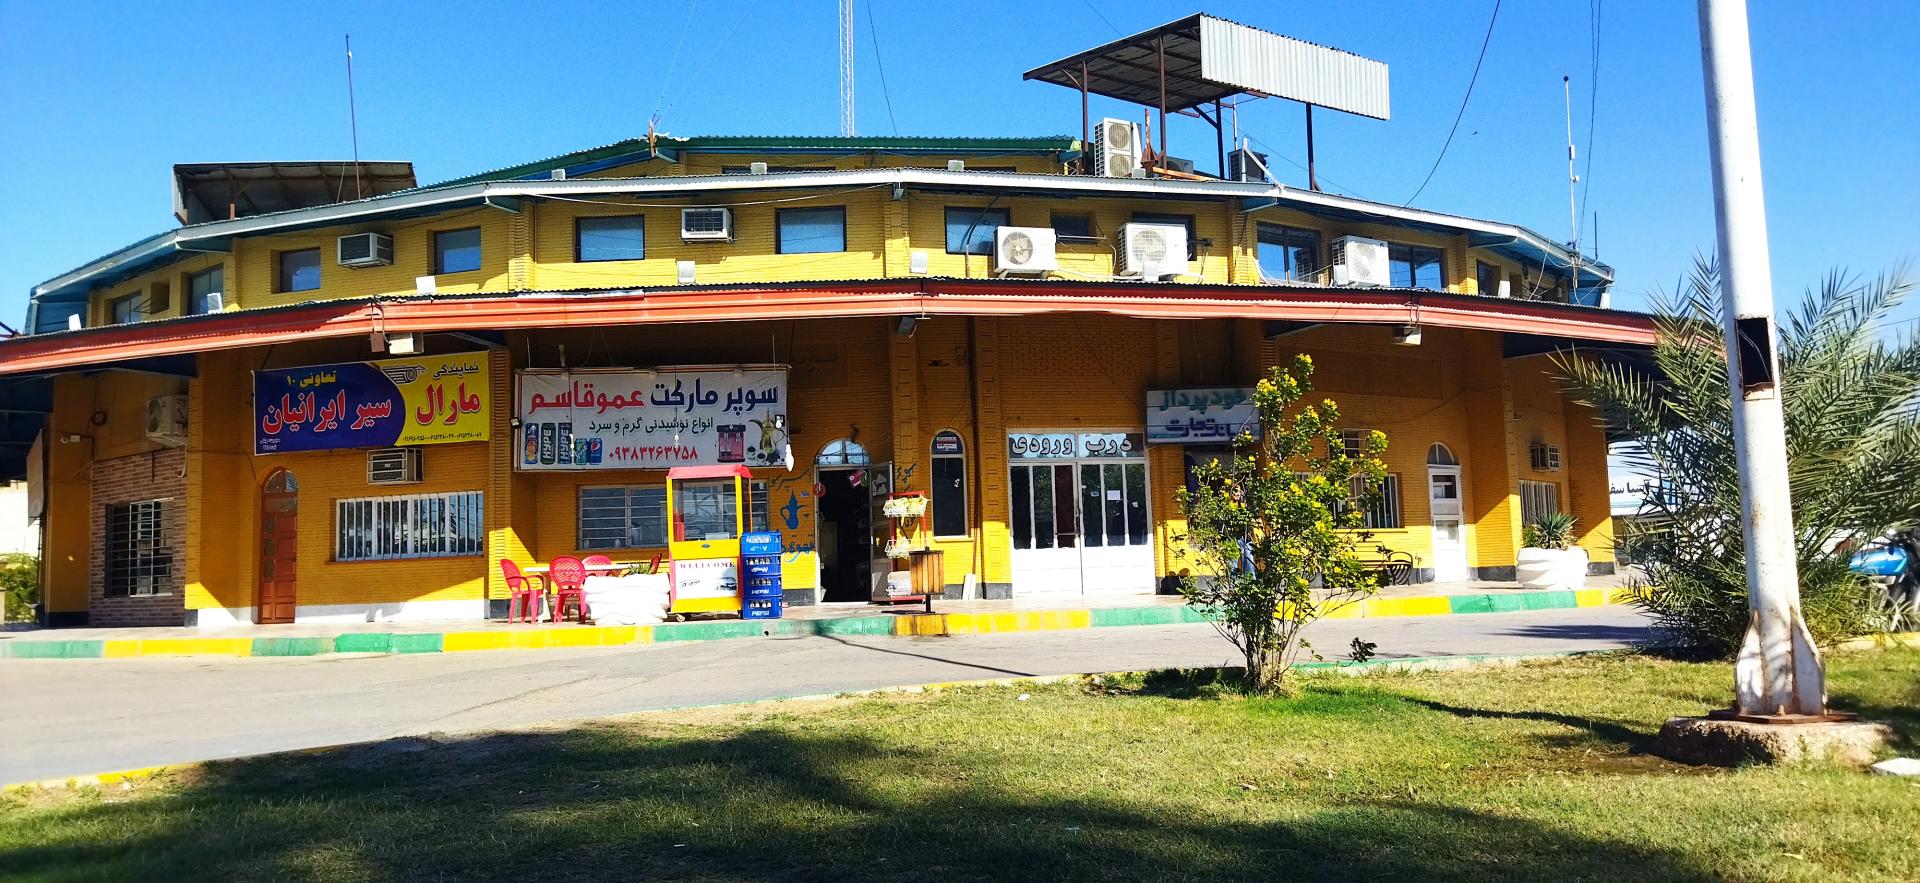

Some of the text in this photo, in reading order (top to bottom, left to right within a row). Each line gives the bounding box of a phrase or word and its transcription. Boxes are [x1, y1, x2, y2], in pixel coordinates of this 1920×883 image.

[300, 370, 336, 389] تعاونی
[415, 381, 482, 426] مارال
[650, 377, 719, 414] مارکت
[722, 385, 779, 416] سوپر
[1159, 388, 1248, 414] خودپرداز
[262, 389, 392, 435] سیر ایرانیان
[588, 416, 714, 437] انواع نوشیدنی گرم و سرد
[543, 429, 552, 459] HYPE
[560, 429, 569, 459] HYPE
[609, 445, 698, 462] ۰۹۳۸۳۲۶۳۷۵۸
[1012, 435, 1133, 456] درب ورودی
[1608, 482, 1625, 495] سف
